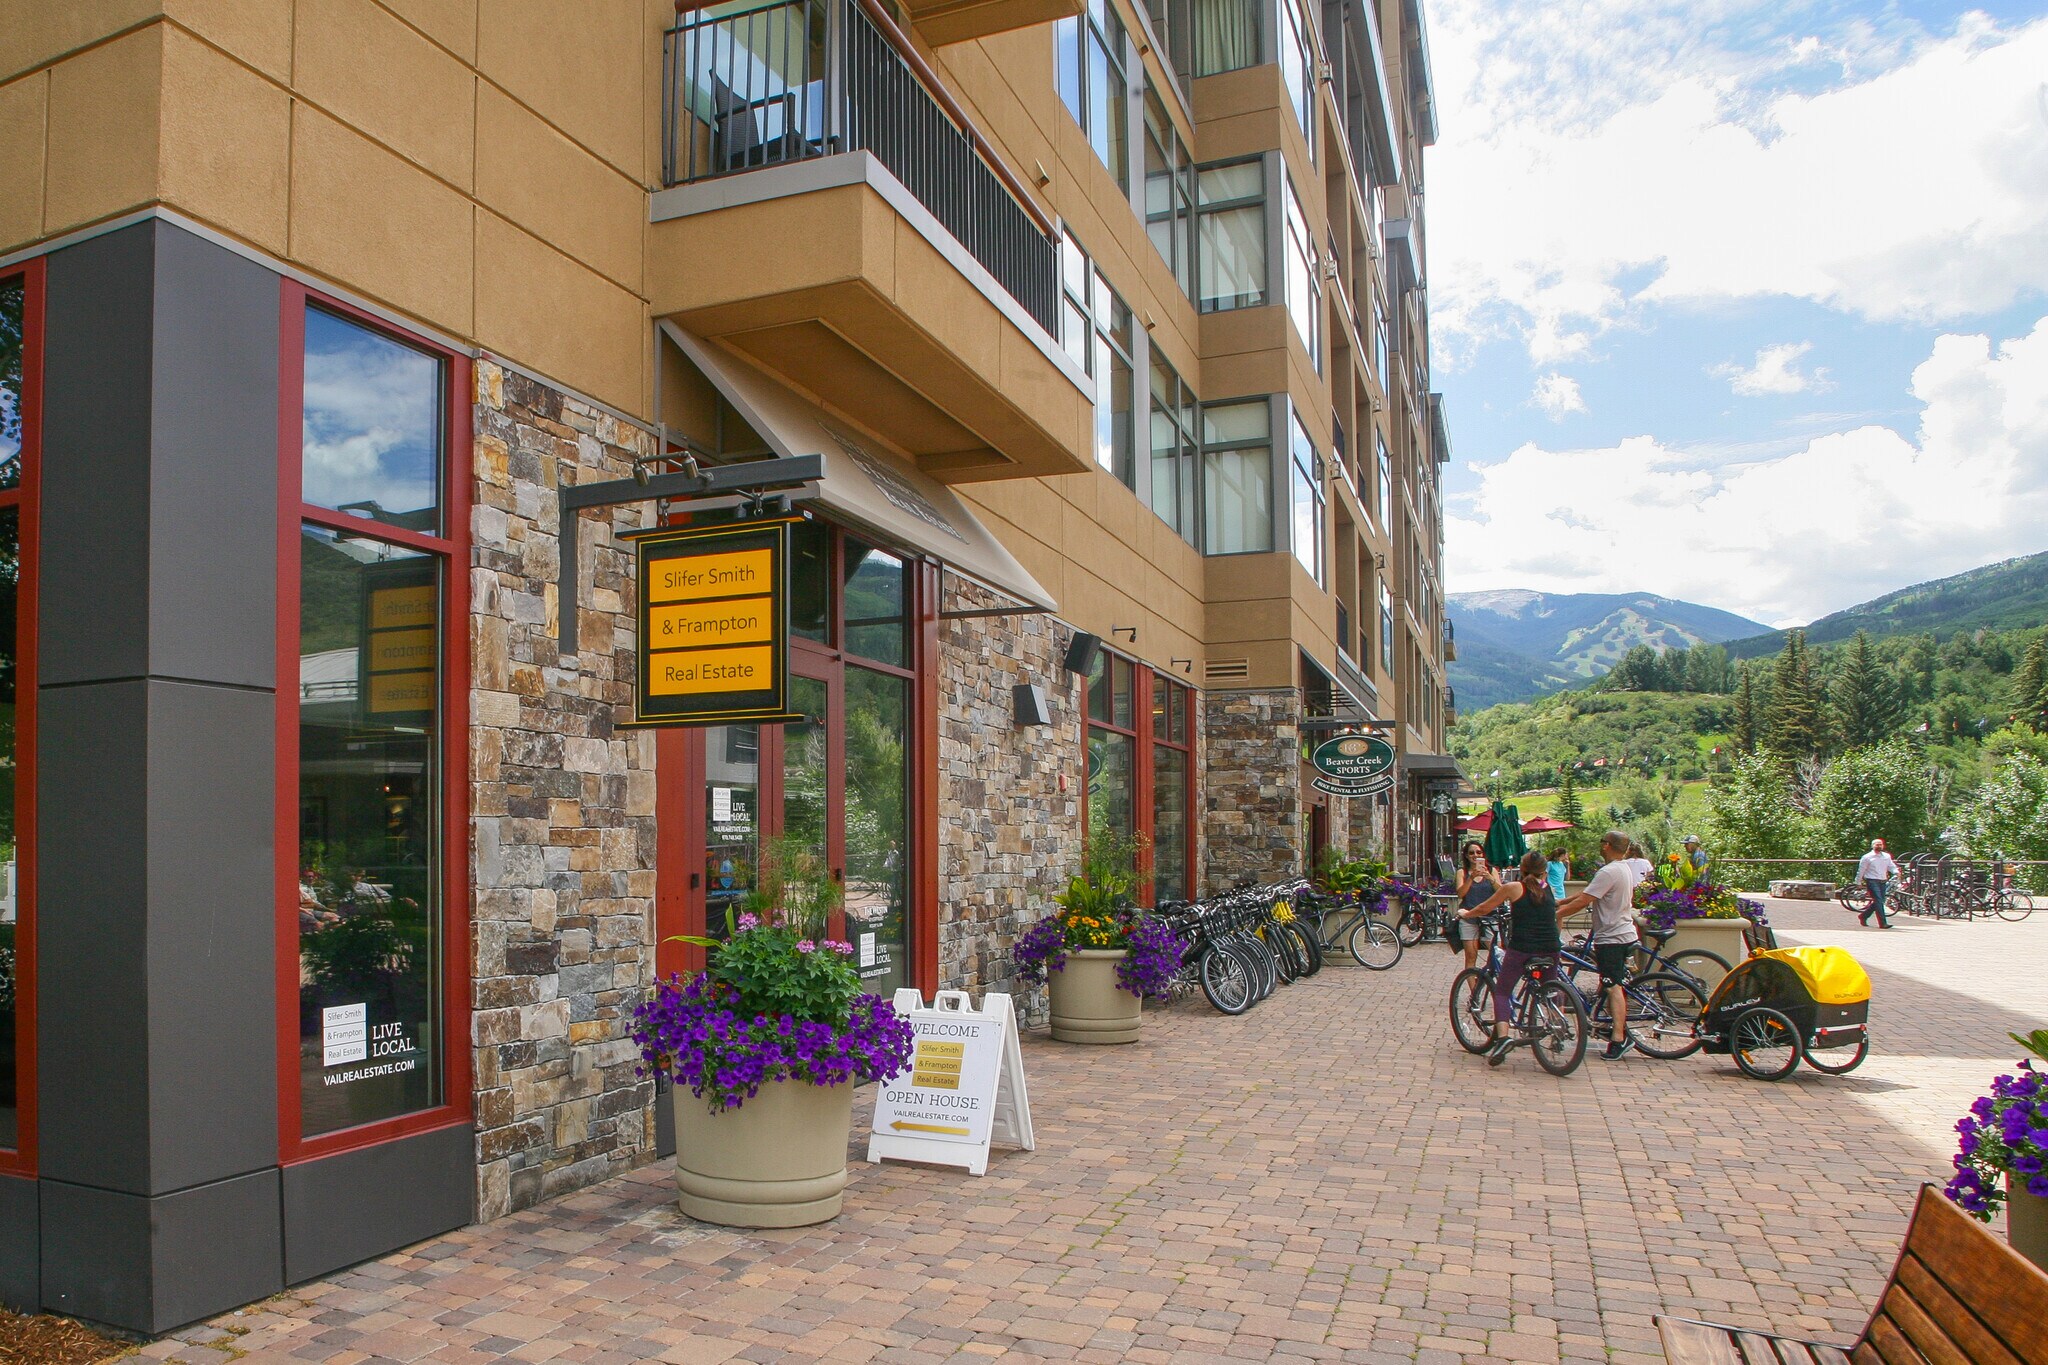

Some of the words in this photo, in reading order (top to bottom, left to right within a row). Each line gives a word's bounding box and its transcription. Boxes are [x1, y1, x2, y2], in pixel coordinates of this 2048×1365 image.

[664, 570, 704, 588] Slifer
[708, 564, 755, 585] Smith
[662, 619, 674, 635] &
[678, 616, 758, 636] Frampton
[665, 663, 699, 682] Real
[702, 663, 754, 680] Estate
[1326, 757, 1353, 766] Beaver
[1356, 756, 1382, 764] Creek
[1336, 766, 1370, 774] SPORTS
[1330, 785, 1351, 793] RENTAL
[733, 803, 746, 811] LIVE
[876, 944, 888, 954] LIVE
[1720, 997, 1761, 1012] BURLEY
[328, 1012, 343, 1021] Slifer
[345, 1009, 362, 1018] Smith
[333, 1028, 362, 1039] Frampton
[372, 1022, 402, 1040] LIVE
[910, 1023, 980, 1038] WELCOME
[328, 1049, 341, 1058] Real
[343, 1047, 362, 1056] Estate
[921, 1044, 939, 1052] Slifer
[940, 1046, 960, 1054] Smith
[924, 1061, 958, 1070] Frampton
[324, 1060, 415, 1086] VAILREALESTATE.COM
[916, 1075, 932, 1083] Real
[886, 1090, 925, 1104] OPEN
[893, 1110, 969, 1123] VAILREALESTATE.COM
